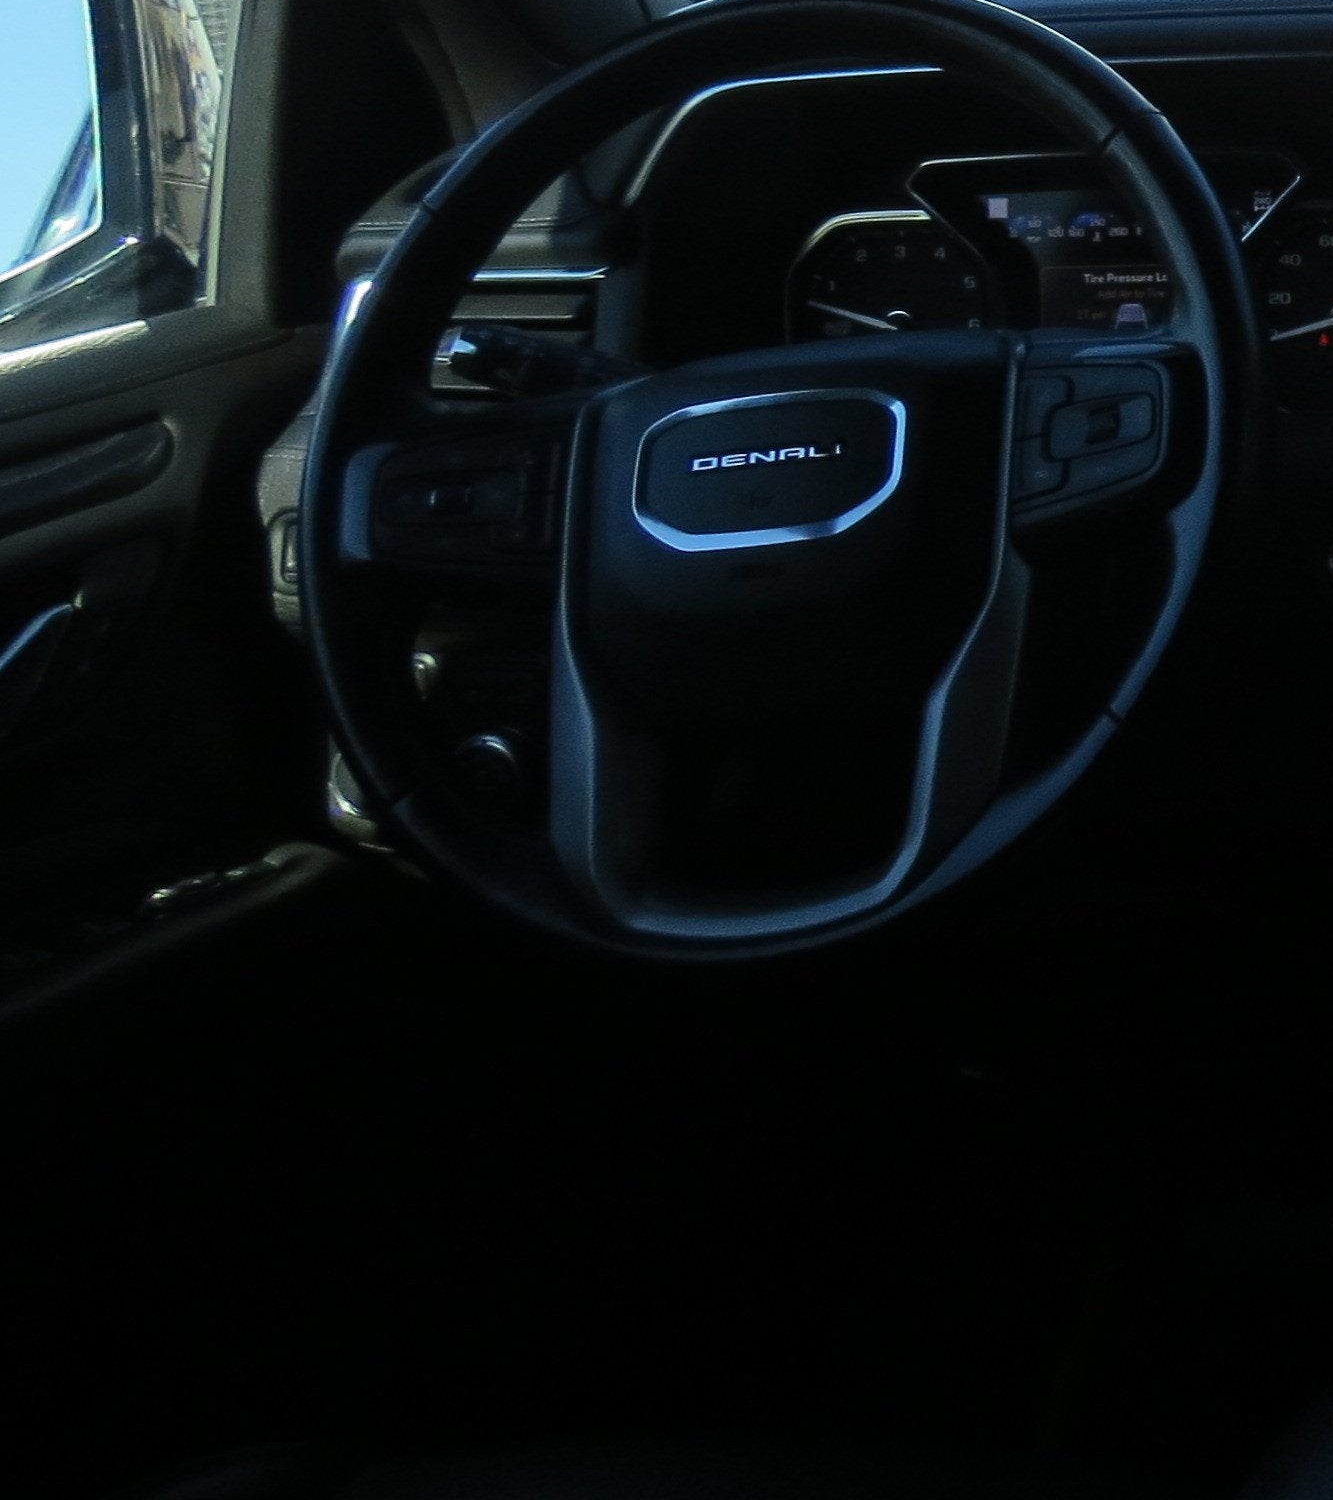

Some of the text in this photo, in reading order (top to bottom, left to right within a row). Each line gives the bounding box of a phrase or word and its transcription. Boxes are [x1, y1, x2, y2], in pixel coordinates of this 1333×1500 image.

[1278, 253, 1303, 268] 40
[1268, 291, 1292, 305] 20
[691, 443, 842, 472] DENALI
